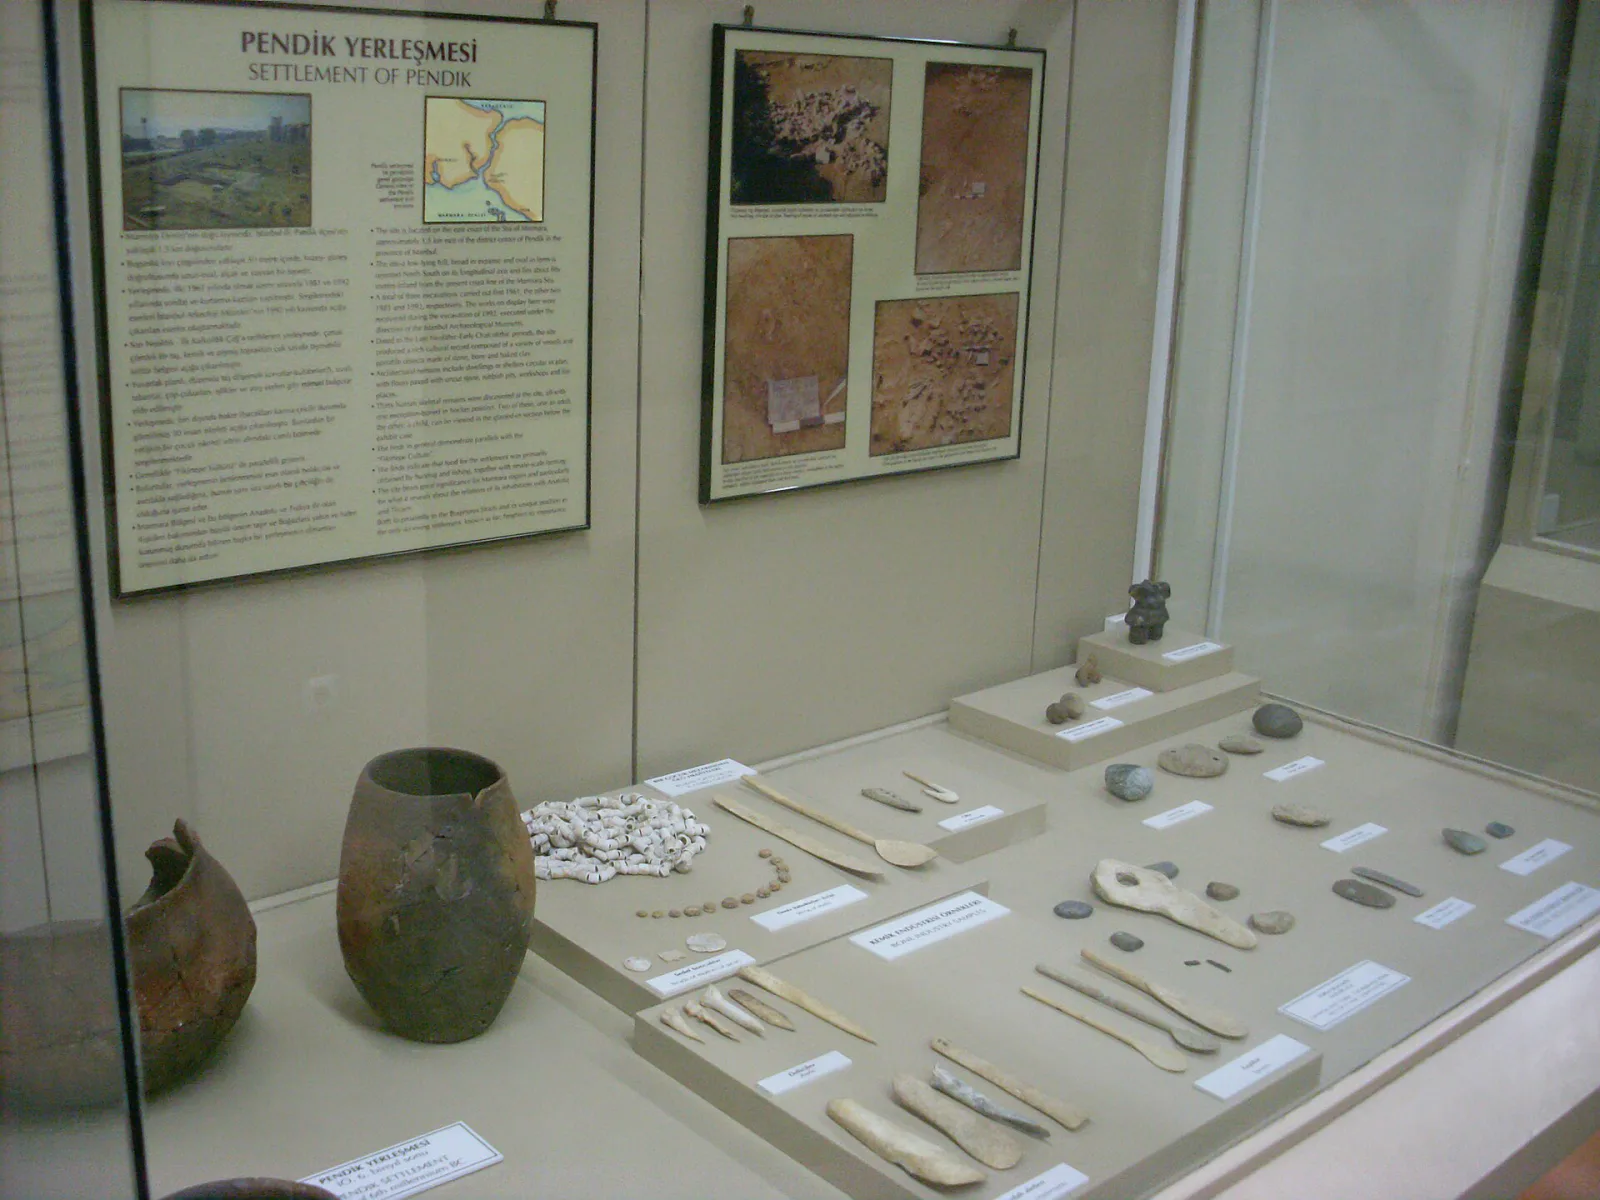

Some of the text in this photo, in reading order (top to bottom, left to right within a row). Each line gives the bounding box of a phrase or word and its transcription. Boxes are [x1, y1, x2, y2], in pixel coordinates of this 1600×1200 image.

[241, 30, 477, 67] PENDİK YERLEŞMESİ
[248, 63, 472, 88] SETTLEMENT OF PENDIK
